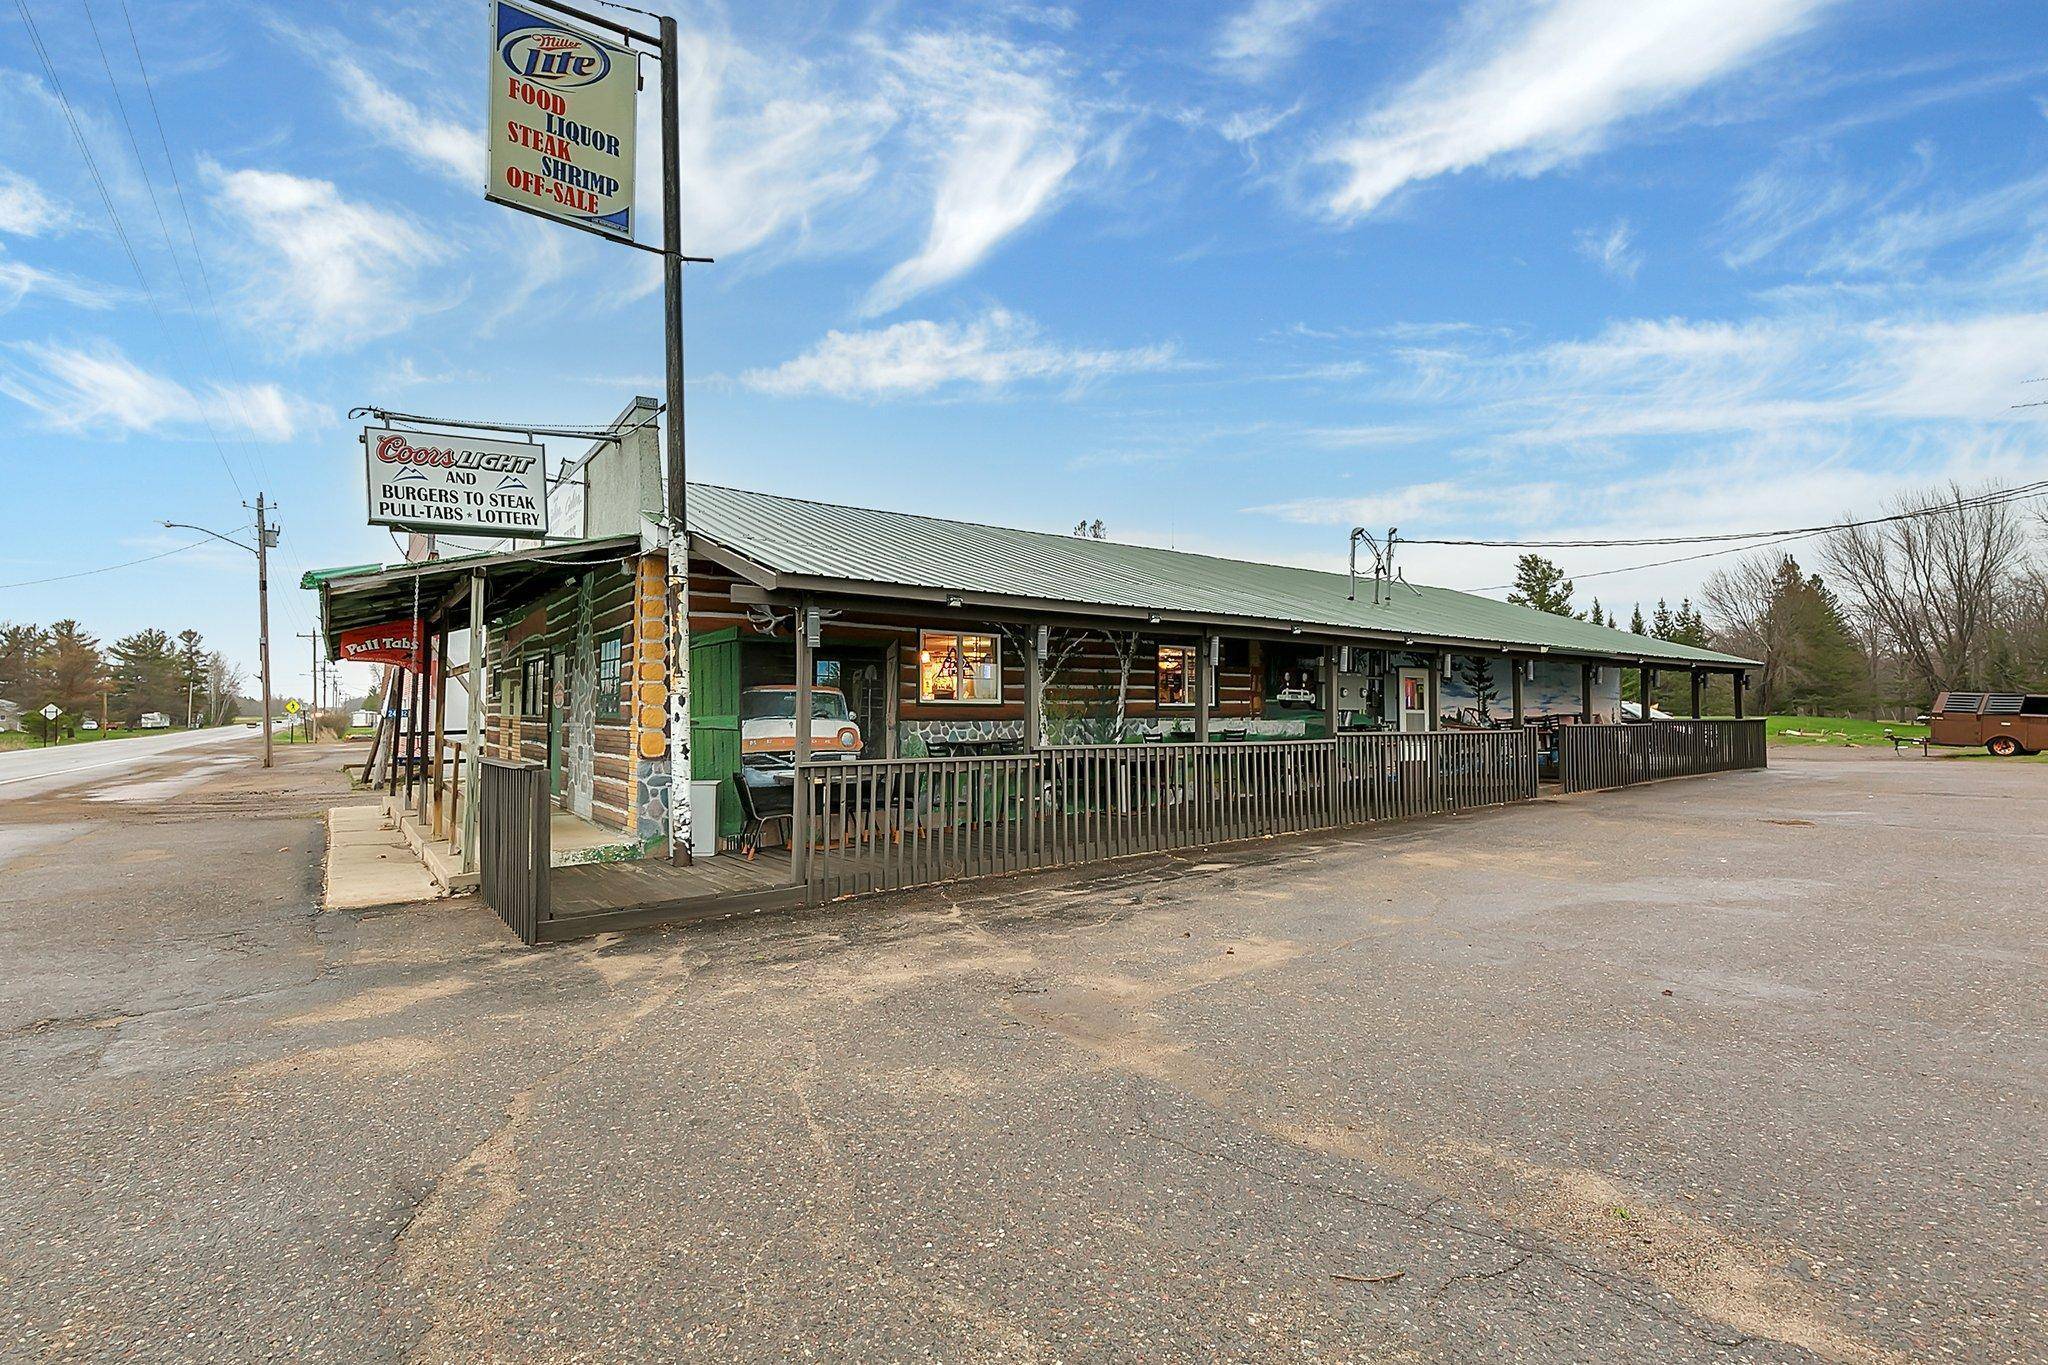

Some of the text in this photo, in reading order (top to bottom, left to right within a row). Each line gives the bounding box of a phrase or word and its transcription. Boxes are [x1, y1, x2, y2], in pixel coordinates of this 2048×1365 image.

[532, 34, 582, 49] Miller
[521, 48, 596, 79] Lite
[508, 77, 567, 116] FOOD
[508, 120, 571, 162] STEAK
[546, 112, 620, 157] LIQUOR
[506, 166, 599, 214] OFF-SALE
[541, 155, 619, 197] SHRIMP
[376, 434, 536, 475] Coors LIGHT
[446, 471, 477, 485] AND
[379, 501, 540, 526] PULL-TABS LOTTERY
[382, 484, 536, 510] BURGERS TO STEAK
[345, 637, 419, 656] Pull Tabs
